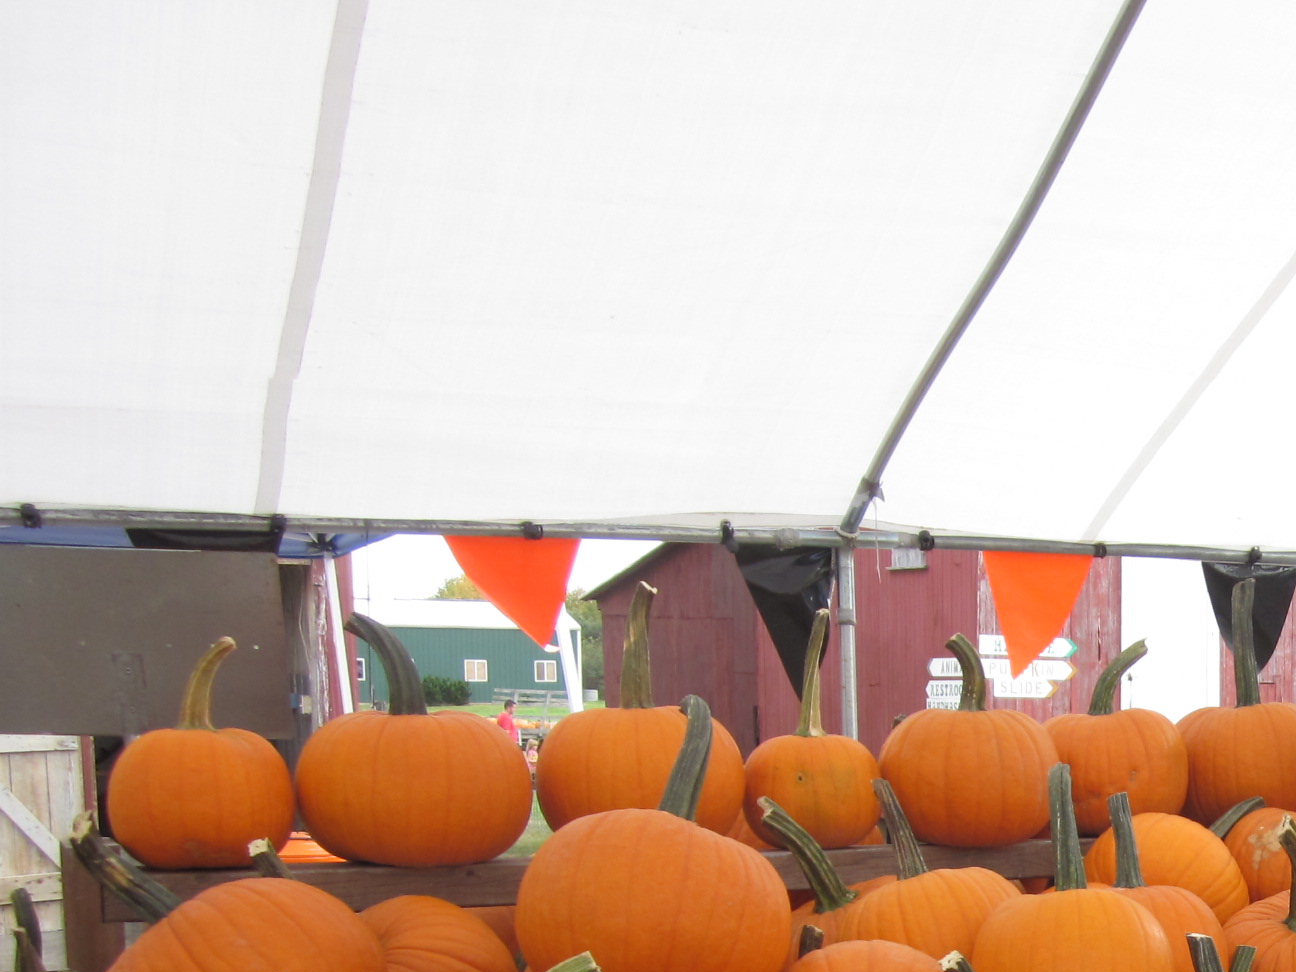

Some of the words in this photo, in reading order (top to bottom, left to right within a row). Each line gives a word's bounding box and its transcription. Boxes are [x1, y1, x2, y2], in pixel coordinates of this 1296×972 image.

[941, 661, 962, 674] ANIM
[989, 662, 1054, 678] PUKIN
[1000, 681, 1043, 694] SLIDE
